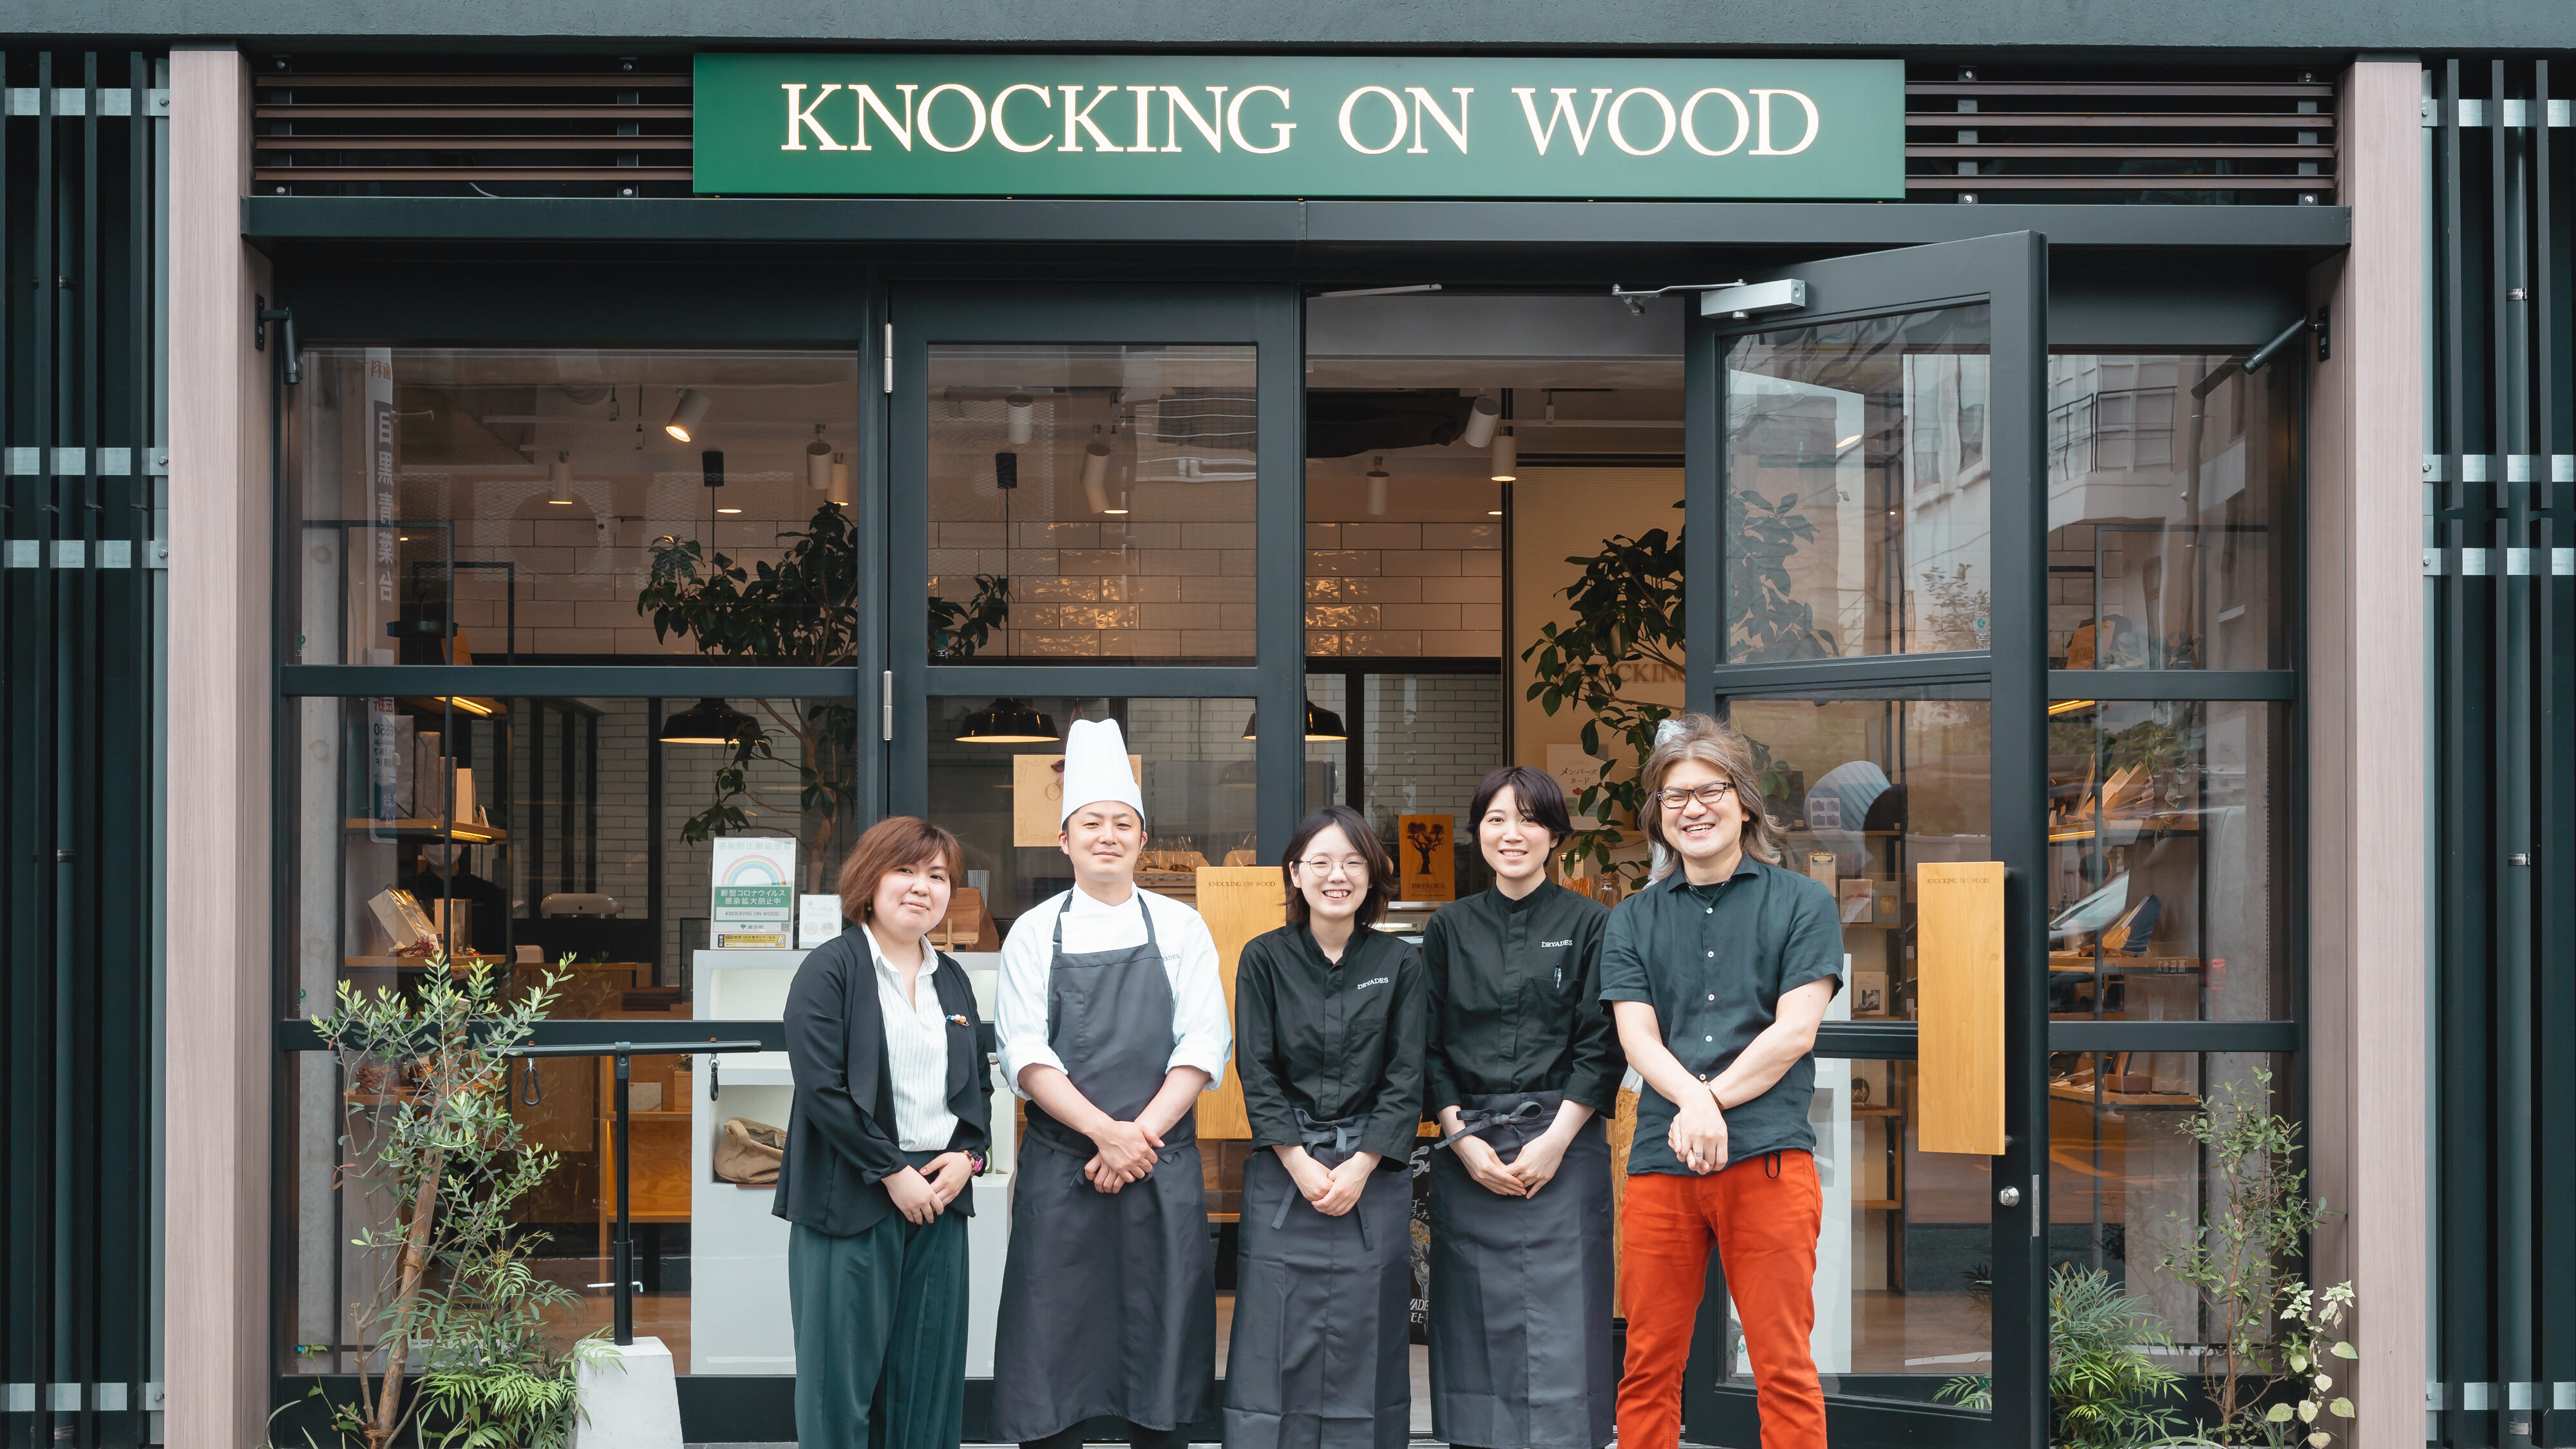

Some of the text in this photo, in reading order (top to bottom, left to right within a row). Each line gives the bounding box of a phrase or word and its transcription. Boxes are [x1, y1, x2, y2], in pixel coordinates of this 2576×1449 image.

[781, 83, 1820, 157] KNOCKING ON WOOD
[1559, 768, 1597, 777] メンバーズ
[1570, 777, 1590, 786] カード
[1541, 940, 1573, 948] DRYADES
[1357, 977, 1389, 990] DRYADES
